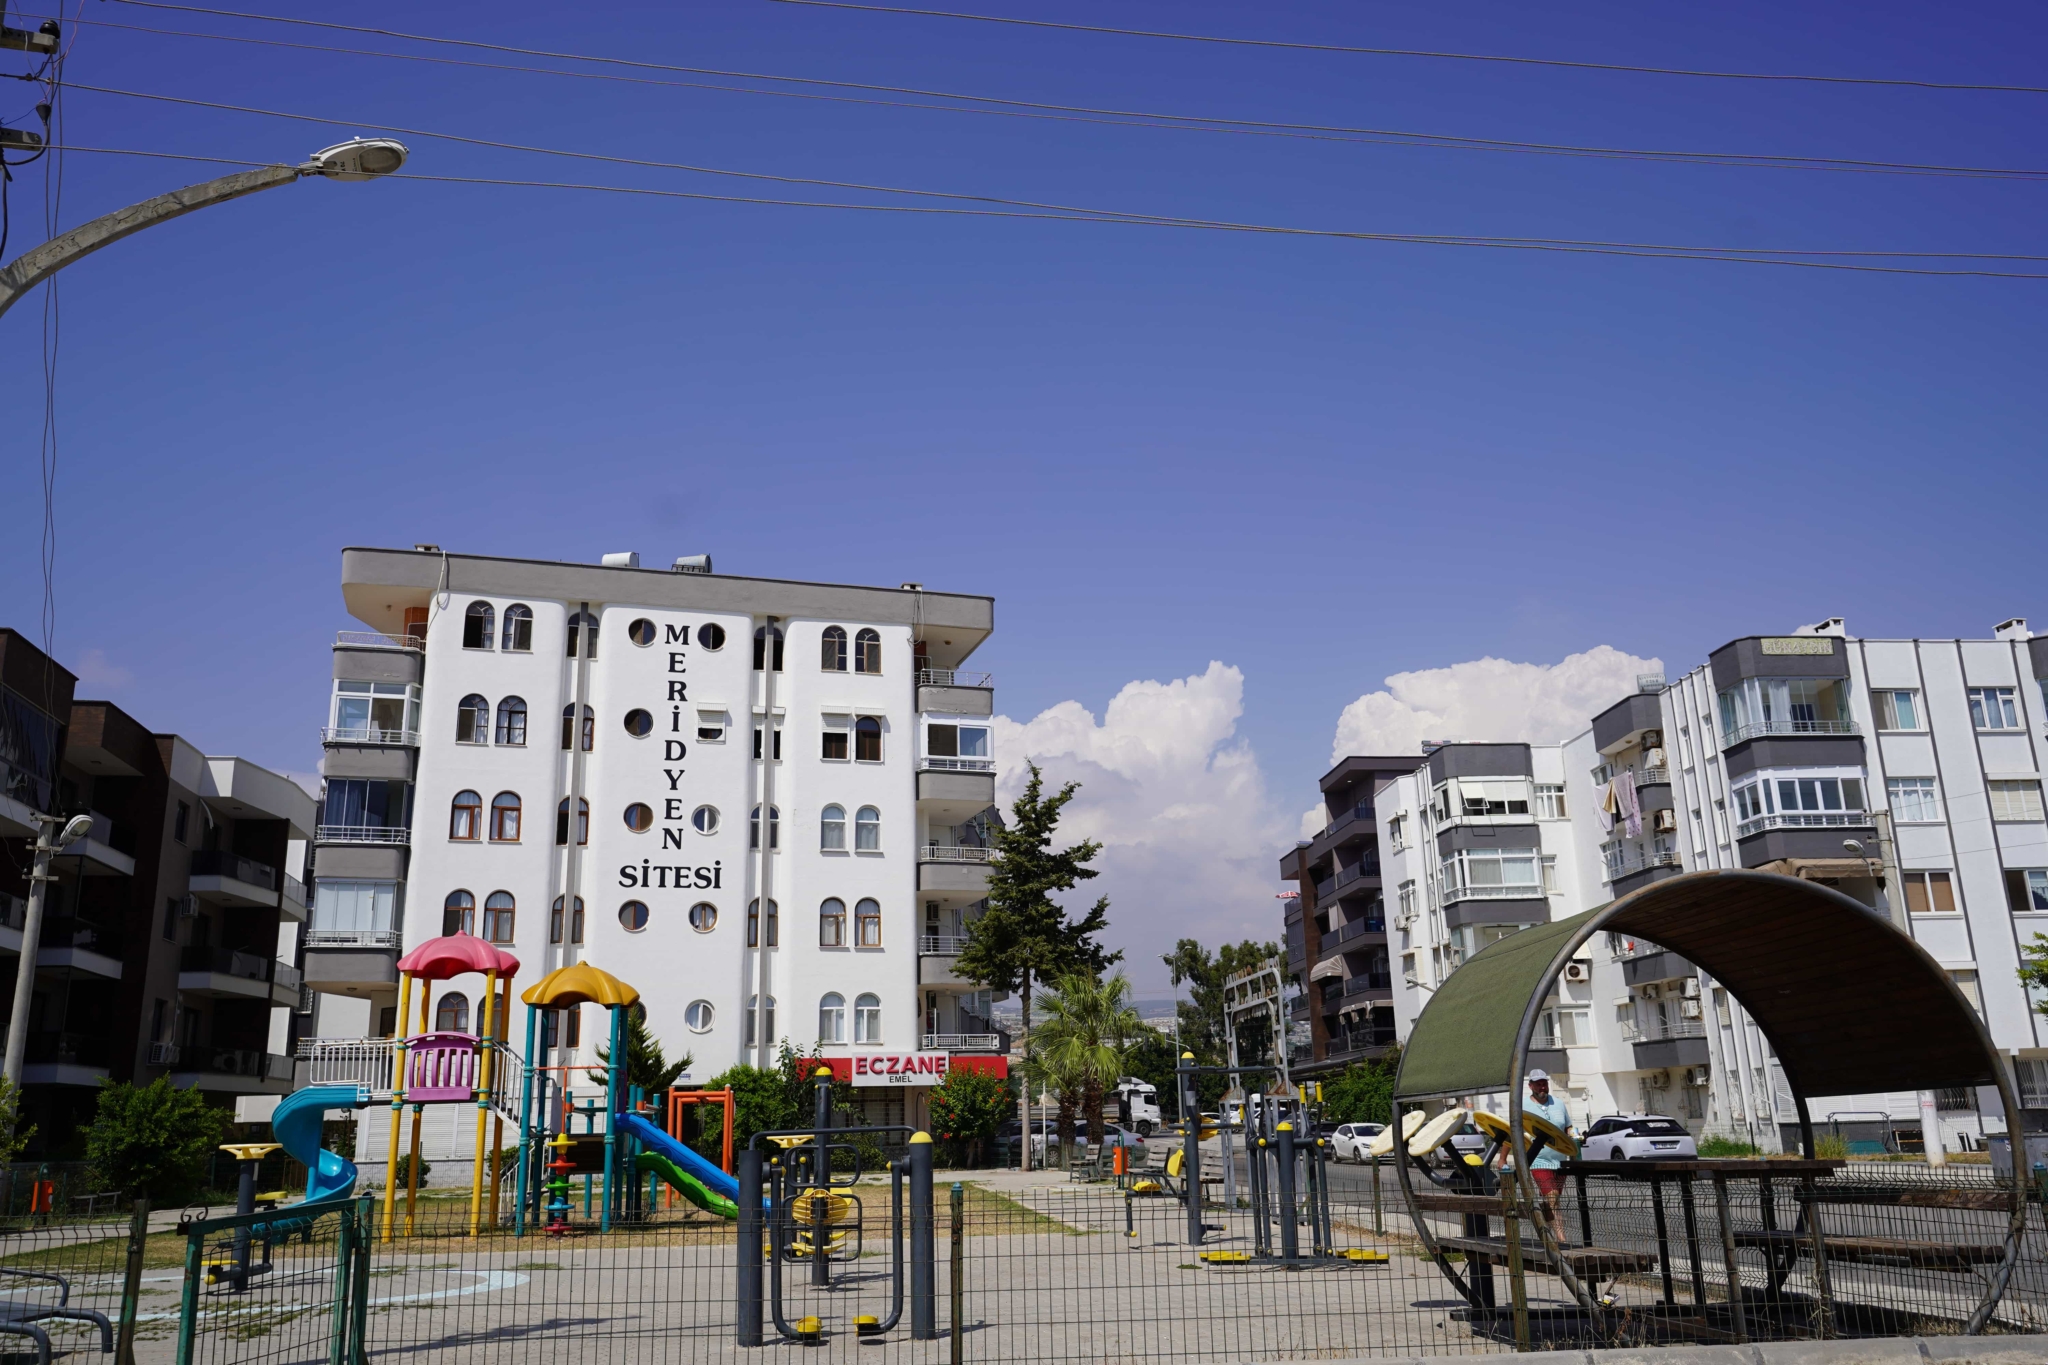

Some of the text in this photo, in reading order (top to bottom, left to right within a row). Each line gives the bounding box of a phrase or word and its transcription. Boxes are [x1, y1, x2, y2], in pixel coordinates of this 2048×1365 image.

[662, 624, 690, 850] MERİDYEN
[618, 858, 722, 889] SİTESİ
[855, 1056, 946, 1075] ECZANE
[889, 1075, 913, 1083] EMEL
